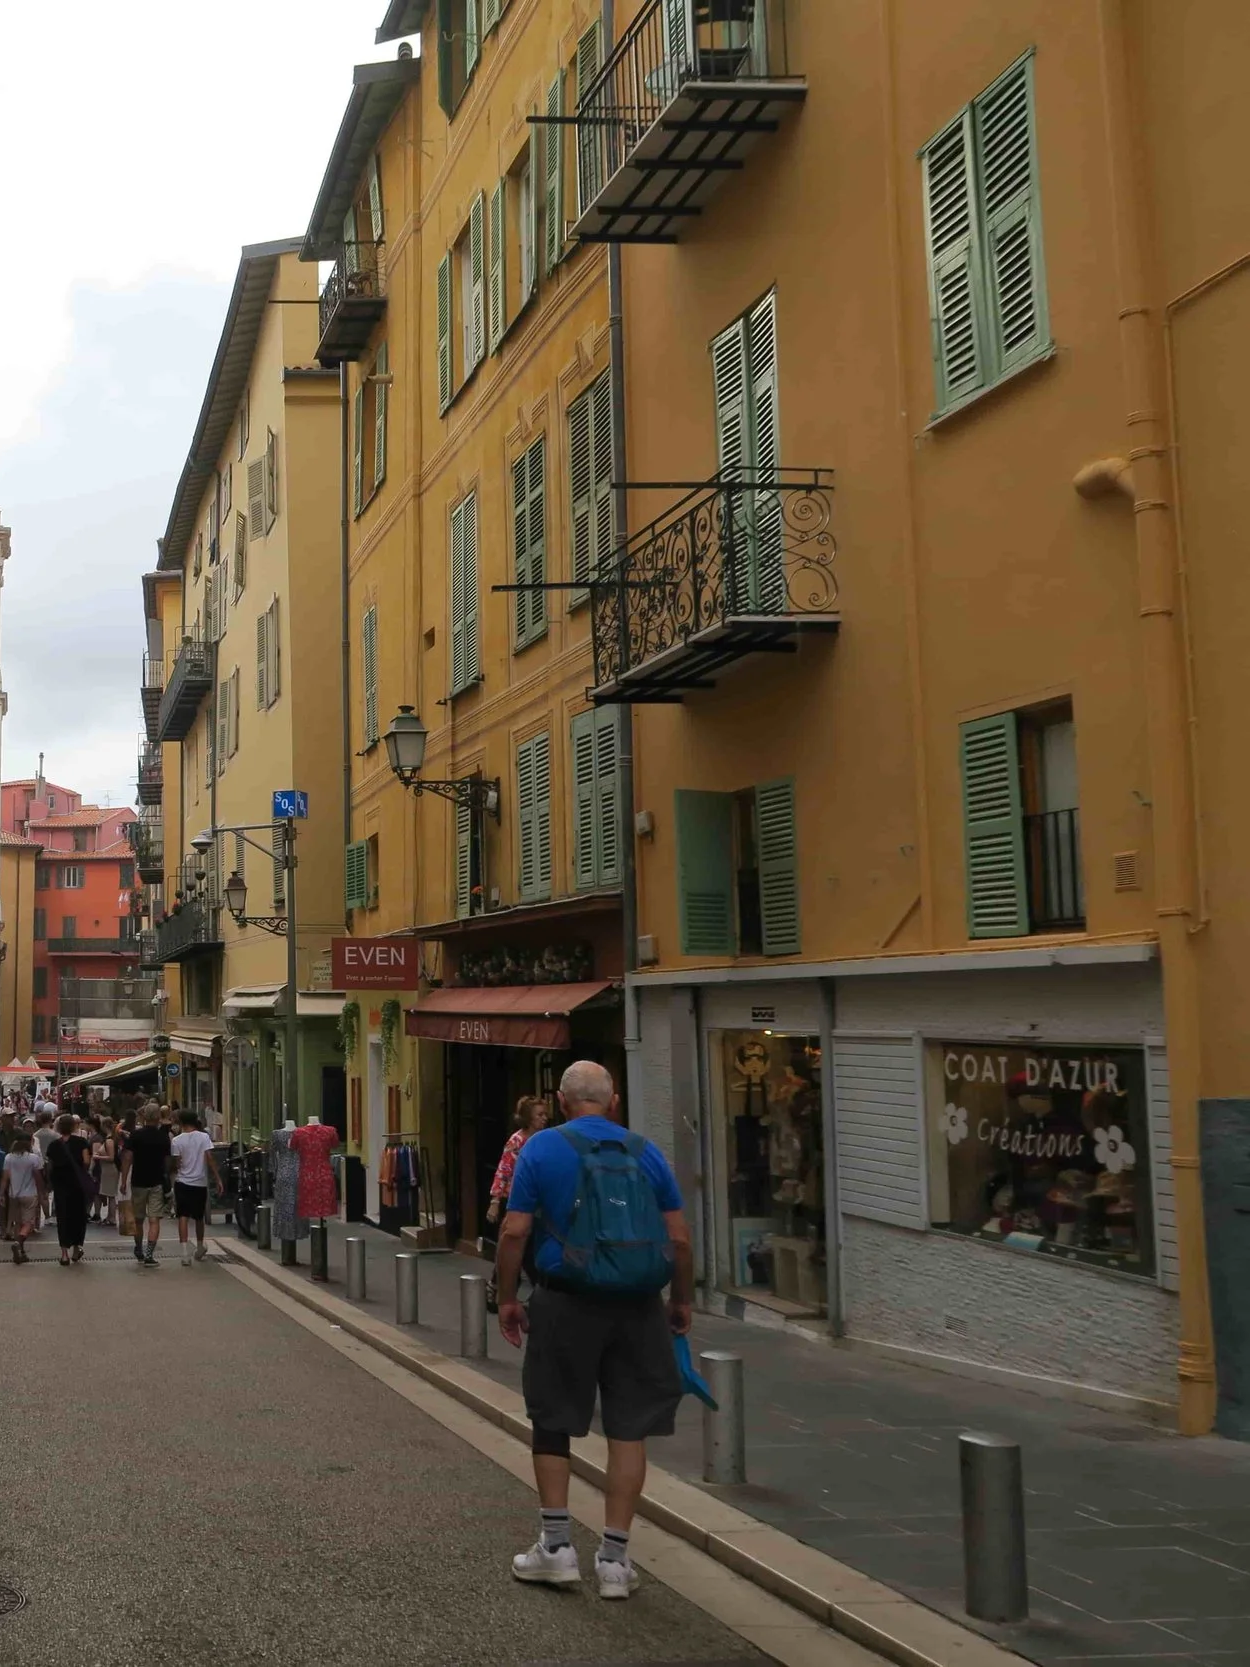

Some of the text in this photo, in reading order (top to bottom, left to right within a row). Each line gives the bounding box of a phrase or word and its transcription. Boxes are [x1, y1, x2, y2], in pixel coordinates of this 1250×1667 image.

[275, 792, 295, 816] SOS
[345, 946, 405, 966] EVEN
[460, 1020, 489, 1040] EVEN
[945, 1053, 1119, 1093] COAT D'AZUR
[977, 1118, 1084, 1157] Créations
